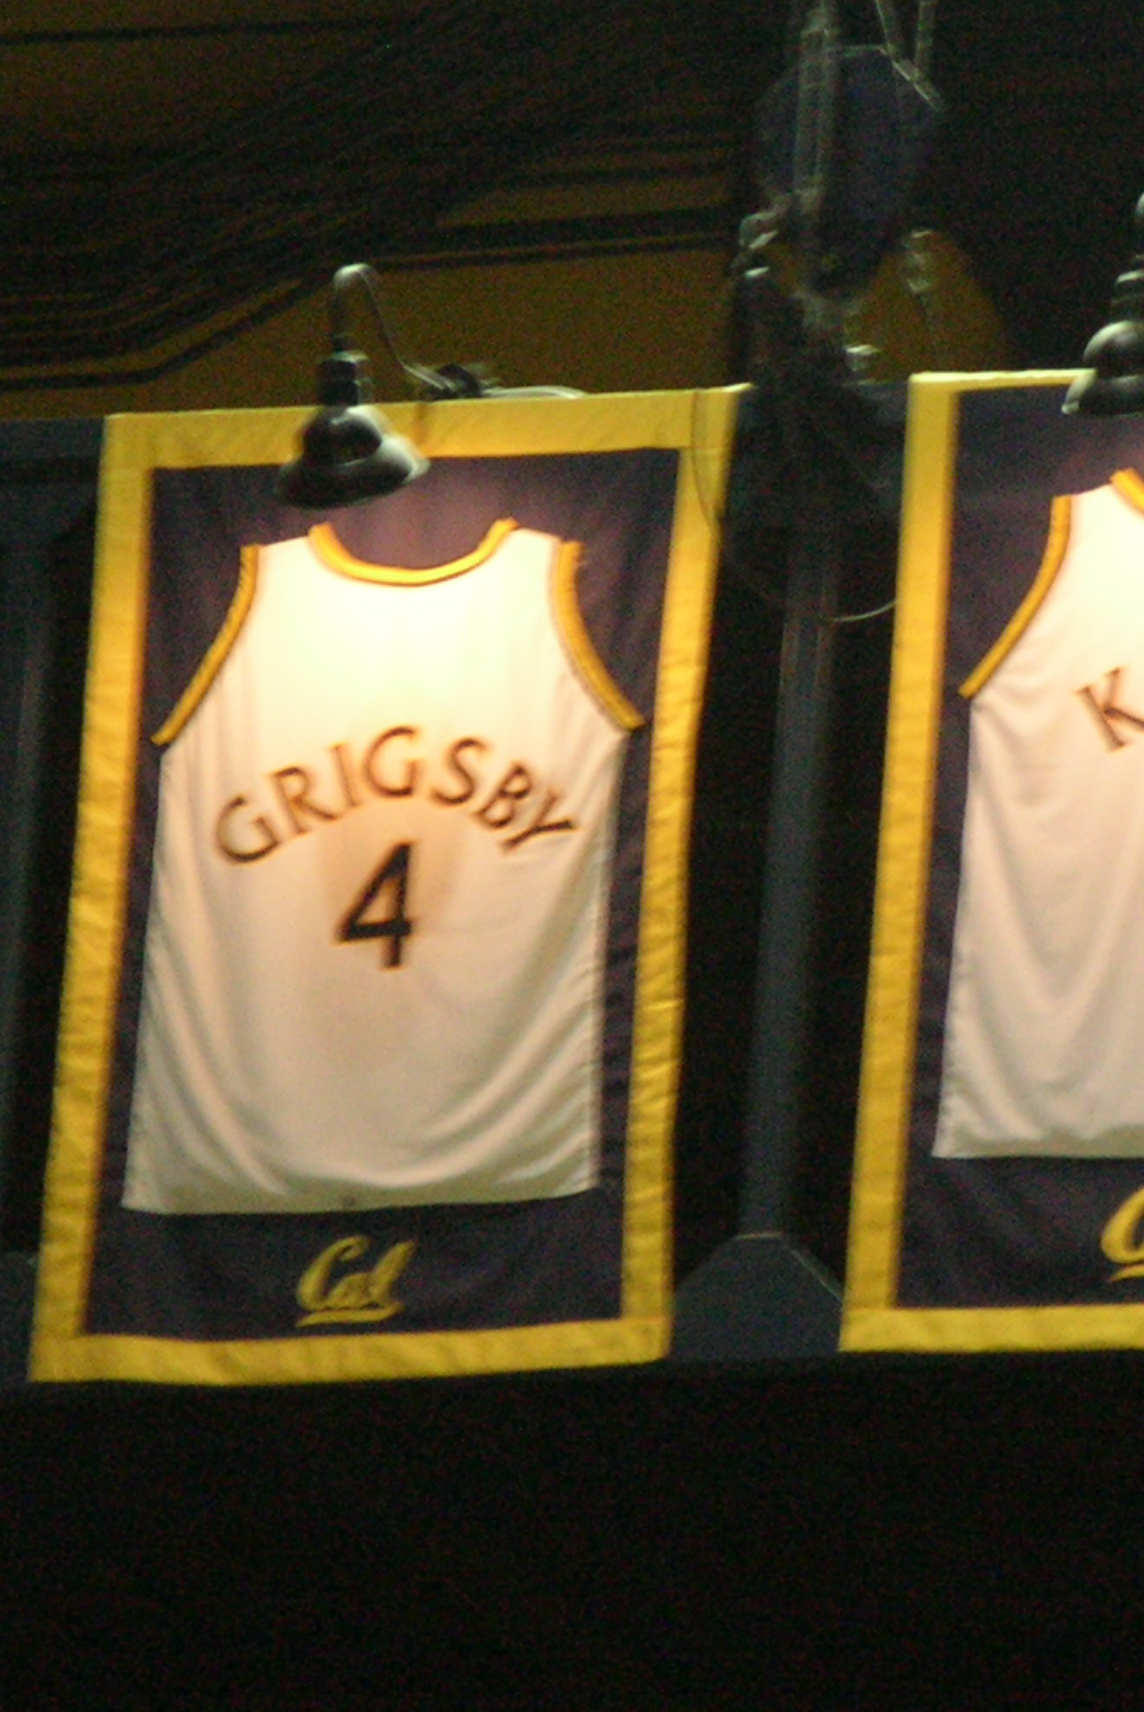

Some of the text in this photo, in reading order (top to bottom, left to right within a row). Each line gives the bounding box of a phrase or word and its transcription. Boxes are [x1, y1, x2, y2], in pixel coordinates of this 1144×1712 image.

[213, 725, 579, 863] GRIGSBY
[335, 840, 419, 970] 4
[296, 1235, 414, 1327] Cal
